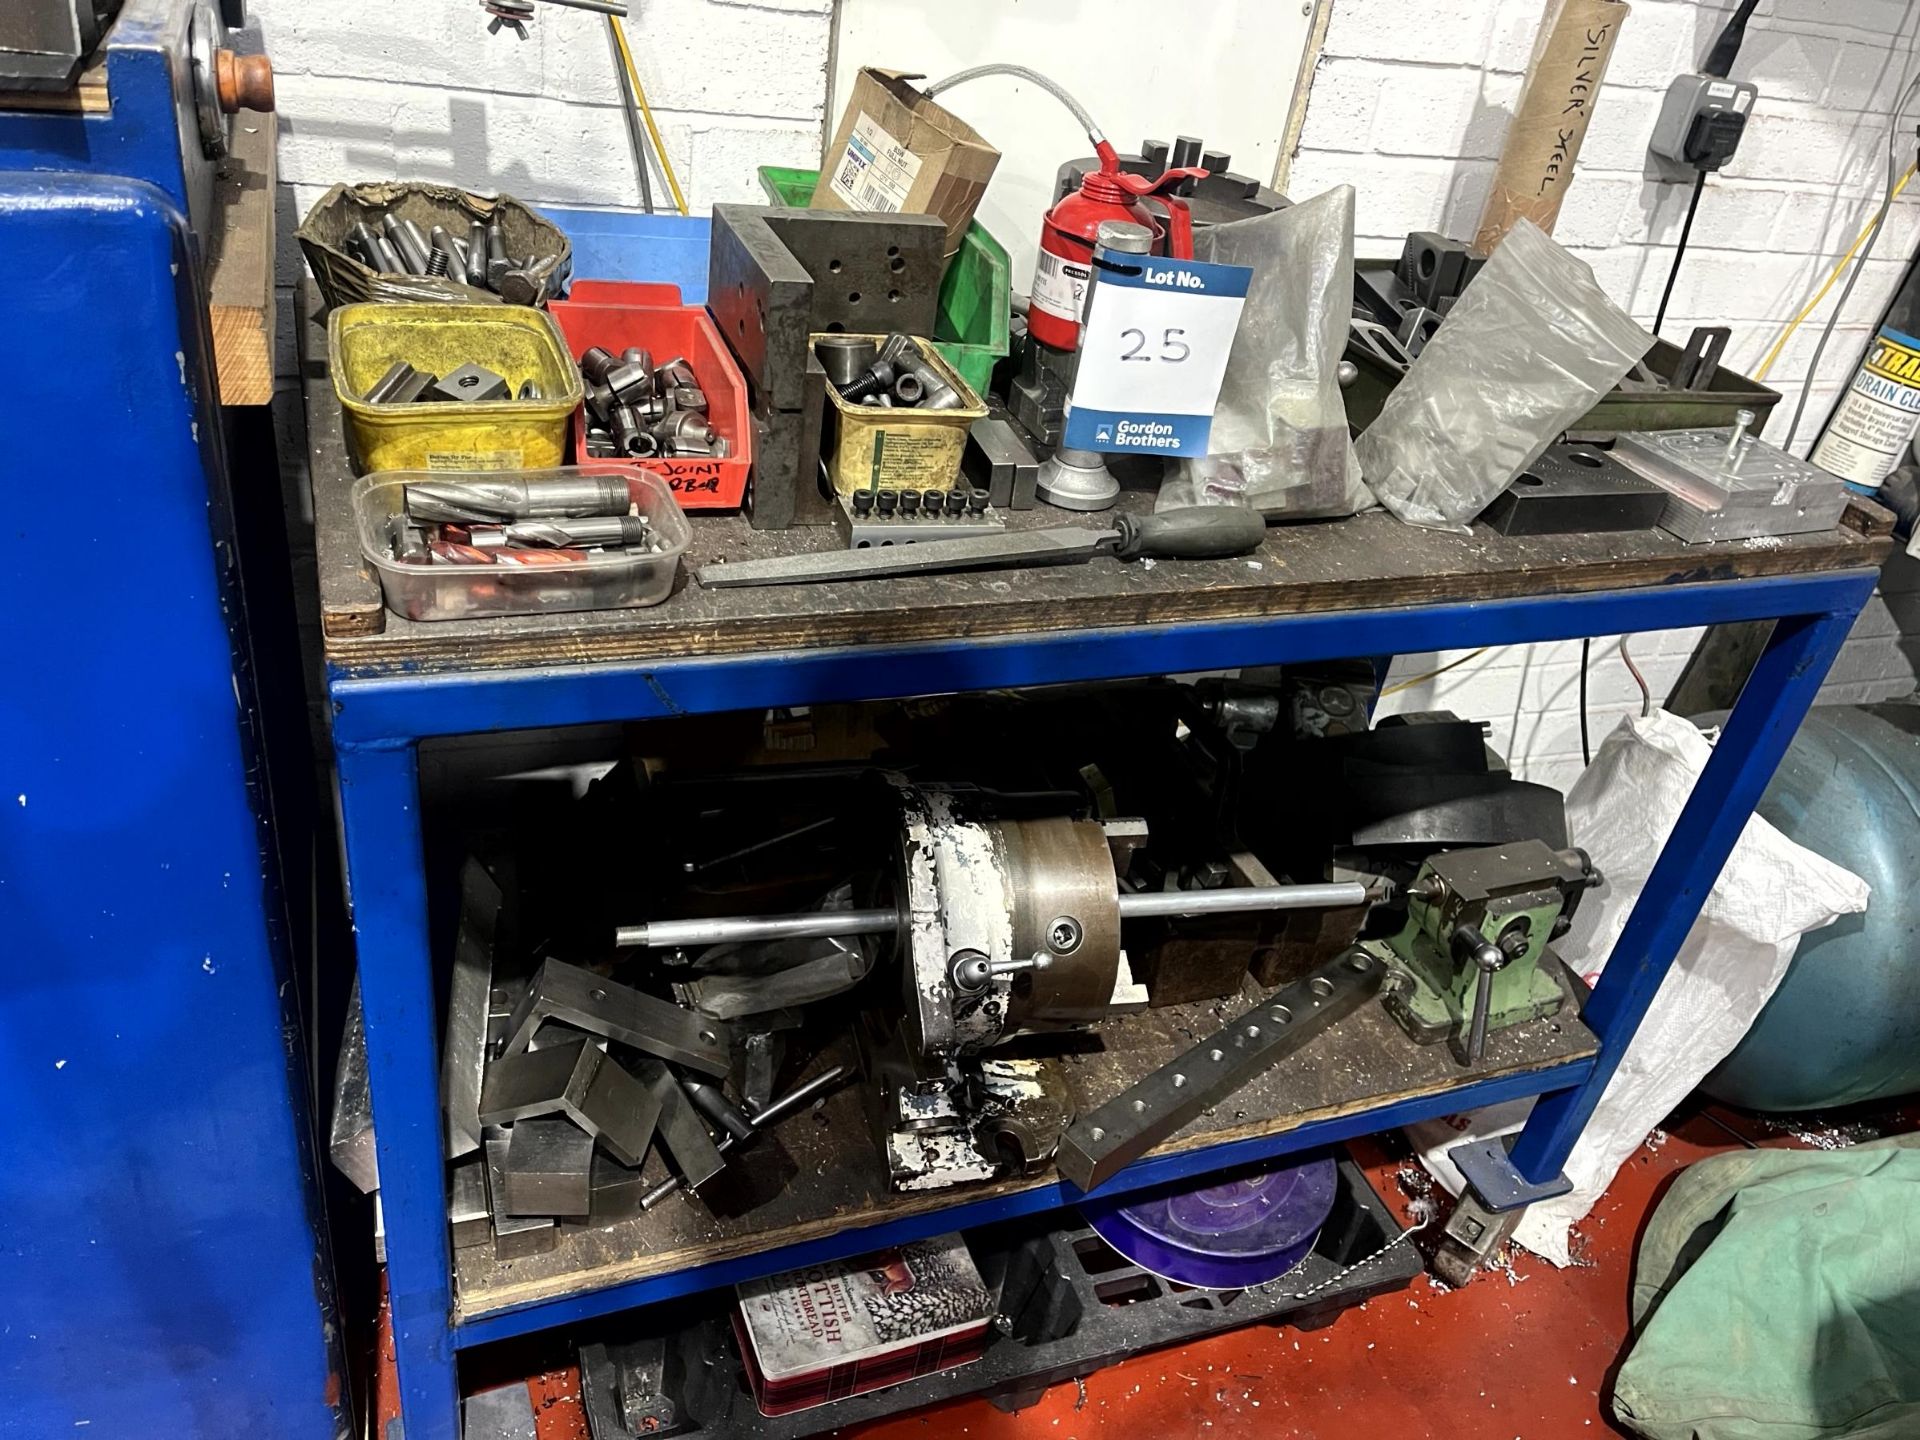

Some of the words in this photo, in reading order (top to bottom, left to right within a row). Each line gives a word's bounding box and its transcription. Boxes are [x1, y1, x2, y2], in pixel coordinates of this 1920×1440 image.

[847, 147, 867, 170] UNIFIX
[886, 149, 898, 163] FULL
[897, 157, 908, 169] NUT
[1145, 267, 1174, 287] Lot
[1176, 271, 1205, 289] No.
[1120, 328, 1191, 362] 25
[1856, 371, 1899, 402] DRAIN
[1117, 420, 1173, 436] Gordon
[1115, 432, 1181, 449] Brothers
[831, 1283, 852, 1324] BUTTER
